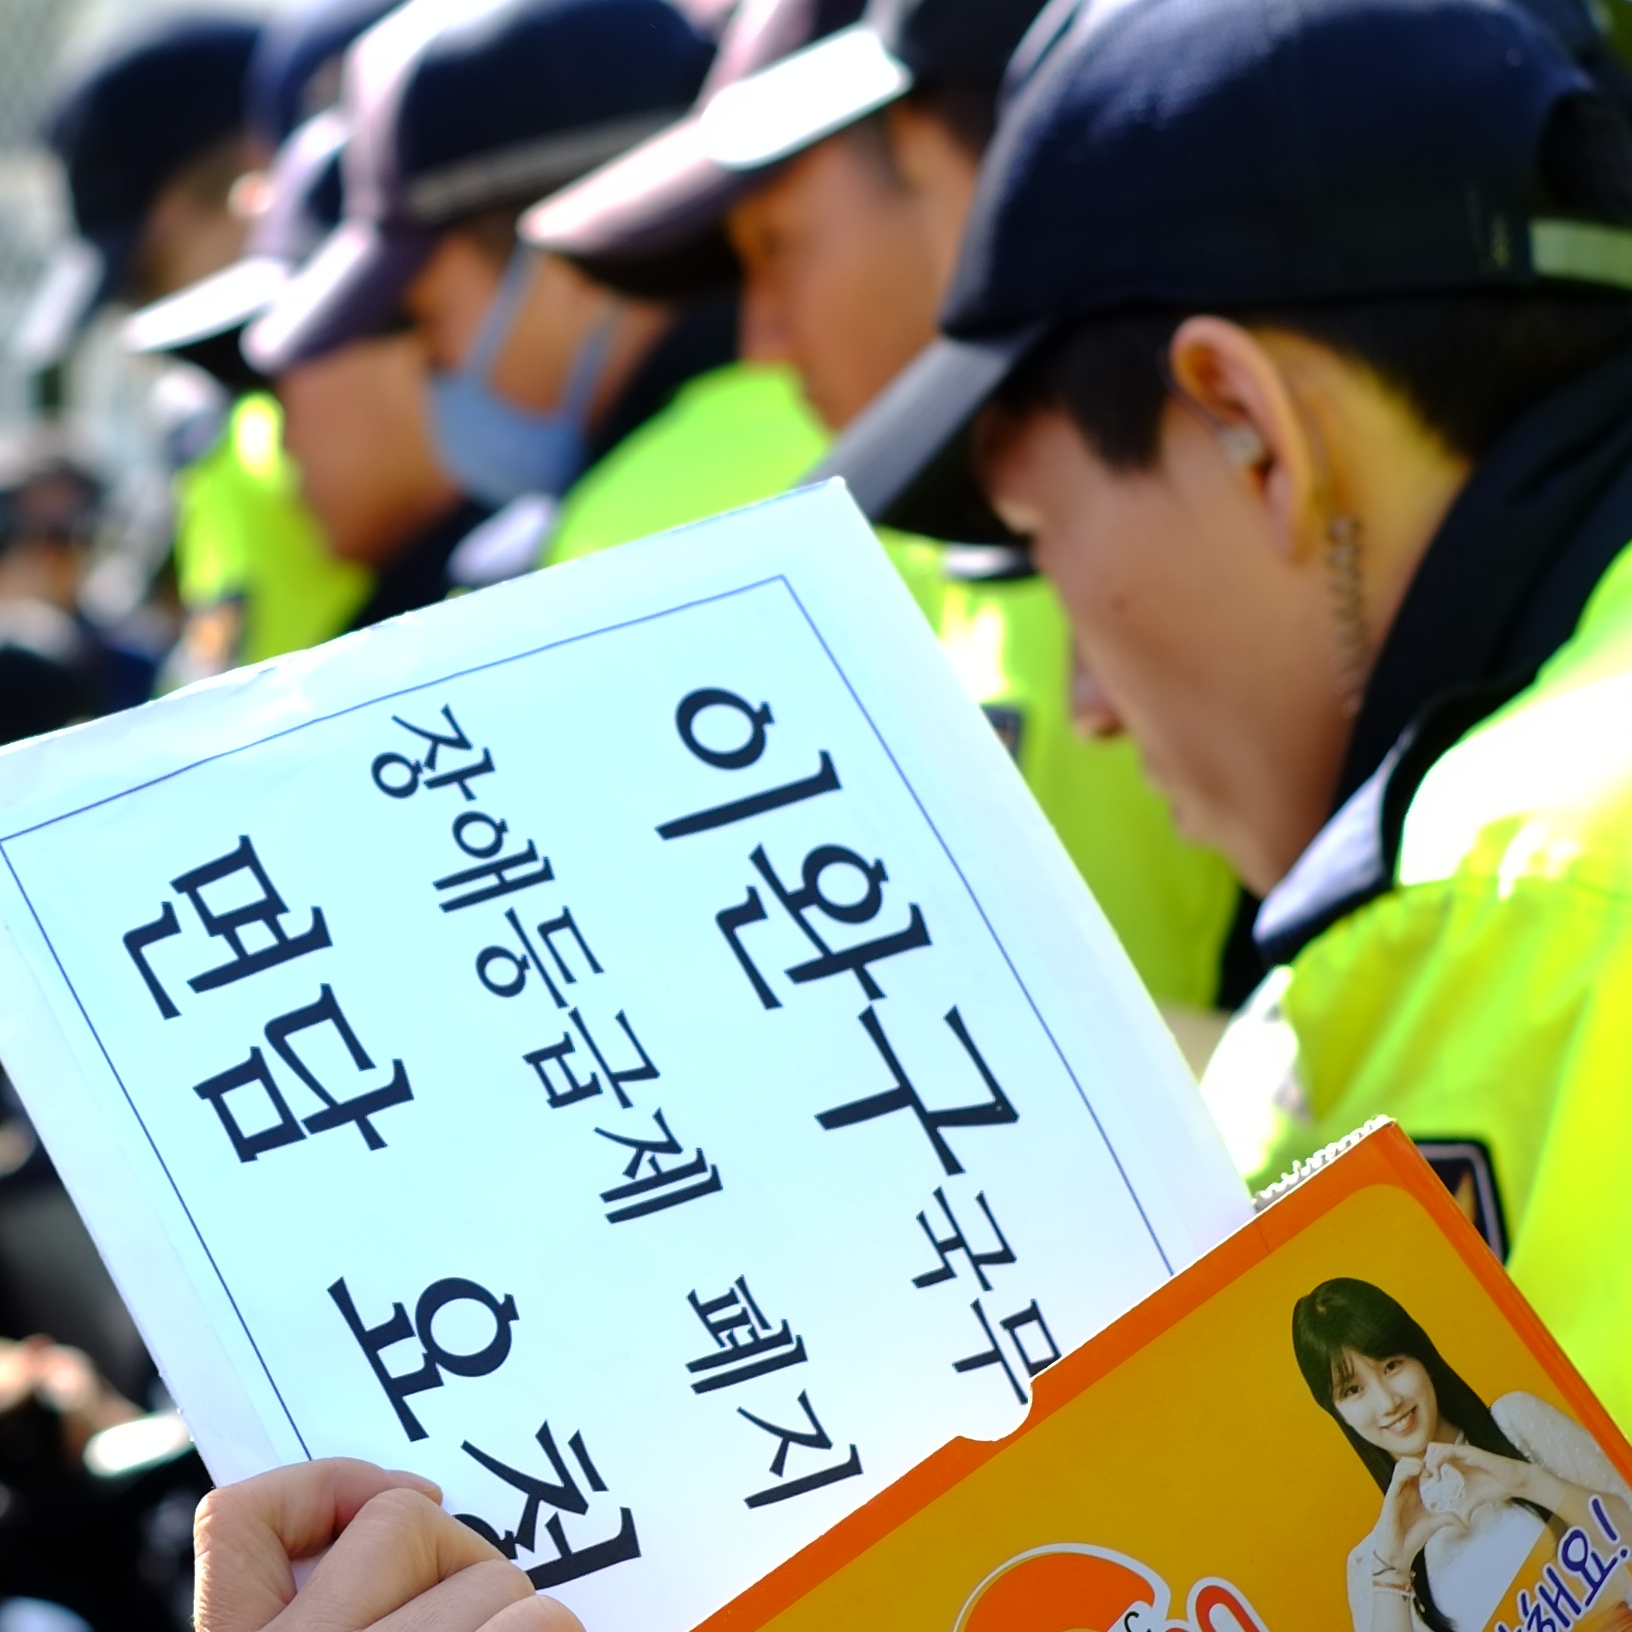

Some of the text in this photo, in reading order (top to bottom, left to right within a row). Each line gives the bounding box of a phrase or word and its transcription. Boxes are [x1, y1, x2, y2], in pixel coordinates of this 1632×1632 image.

[123, 835, 412, 1162] 면담
[371, 705, 861, 1508] 장애등급제 폐지
